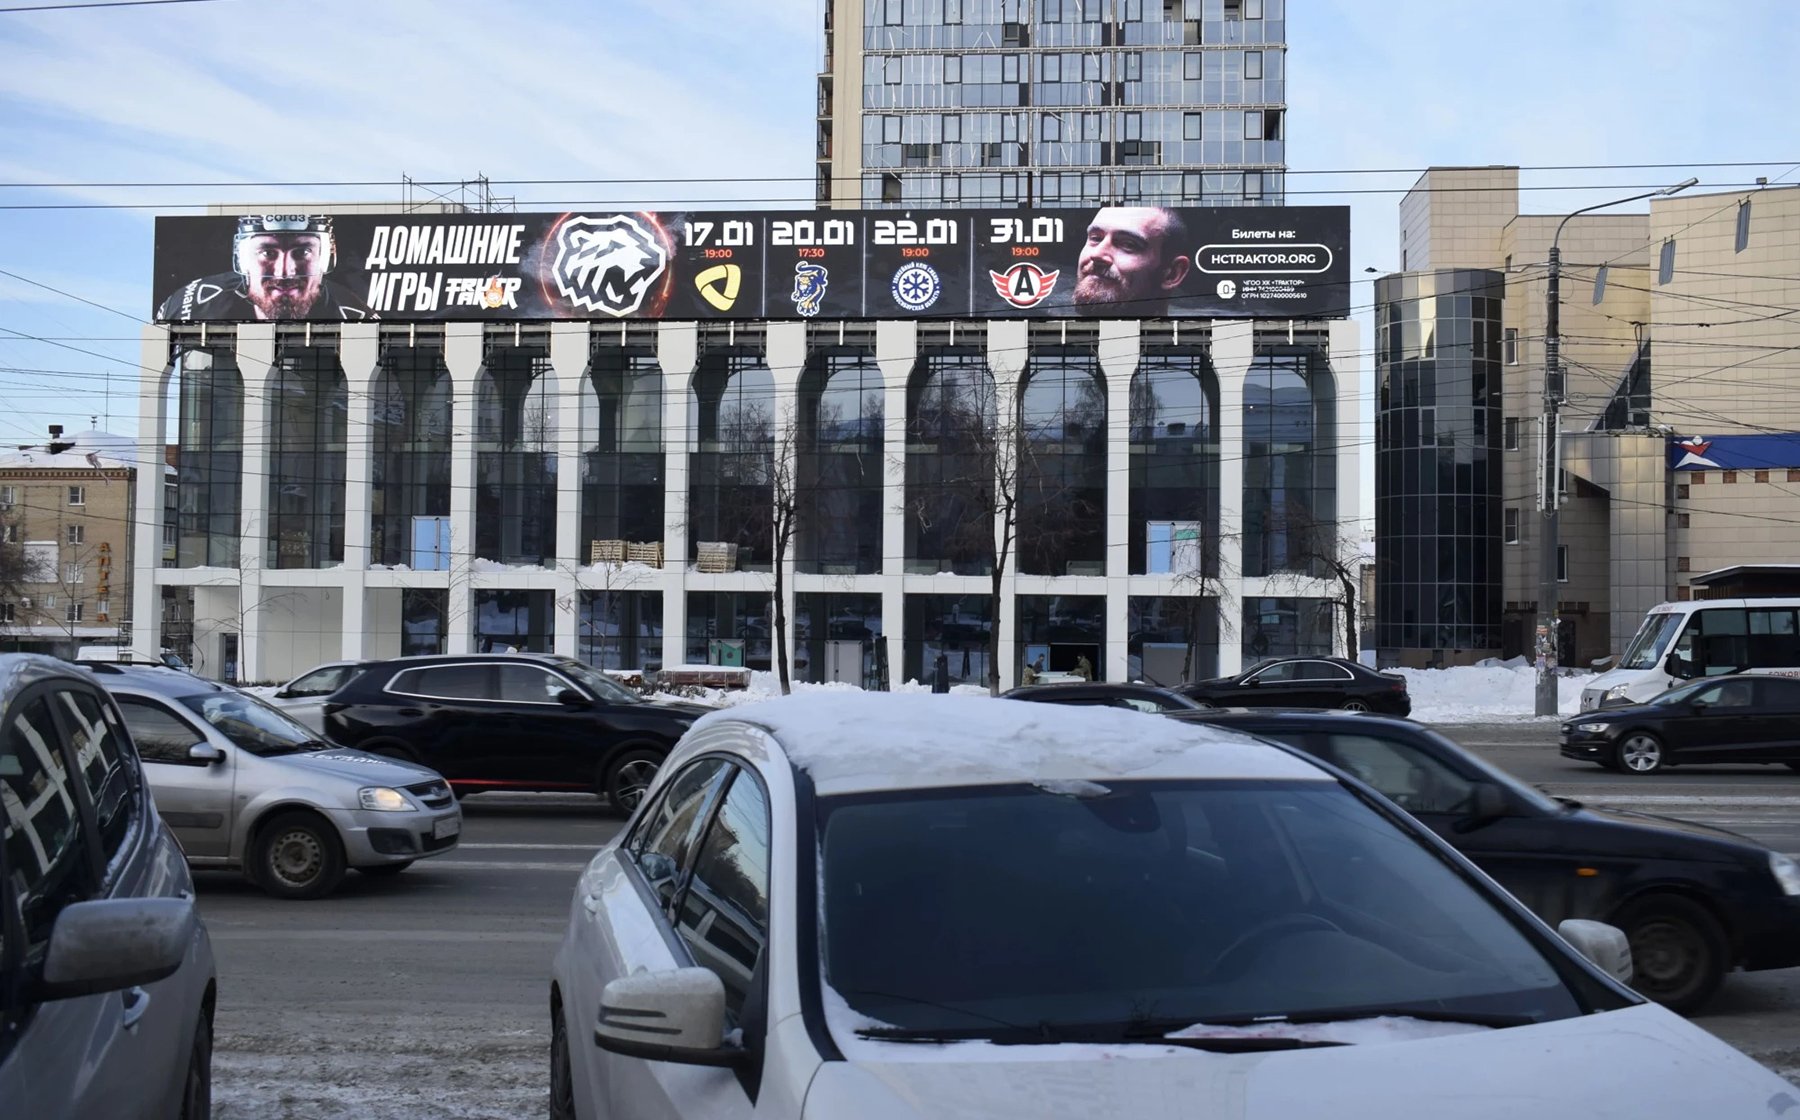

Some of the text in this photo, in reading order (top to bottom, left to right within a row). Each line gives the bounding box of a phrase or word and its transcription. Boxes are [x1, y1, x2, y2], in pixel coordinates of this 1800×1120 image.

[684, 220, 753, 246] 17.01
[772, 219, 854, 246] 20.01
[874, 218, 957, 245] 22.01
[990, 216, 1064, 243] 31.01
[1232, 229, 1296, 239] Билеты на:
[365, 224, 526, 270] ДОМАШНИЕ
[704, 249, 732, 258] 19:00
[798, 248, 825, 257] 17:30
[902, 248, 929, 257] 19:00
[1011, 247, 1039, 256] 19:00
[1211, 254, 1316, 264] HCTRAKTOR.ORG
[367, 272, 443, 311] ИГРЫ
